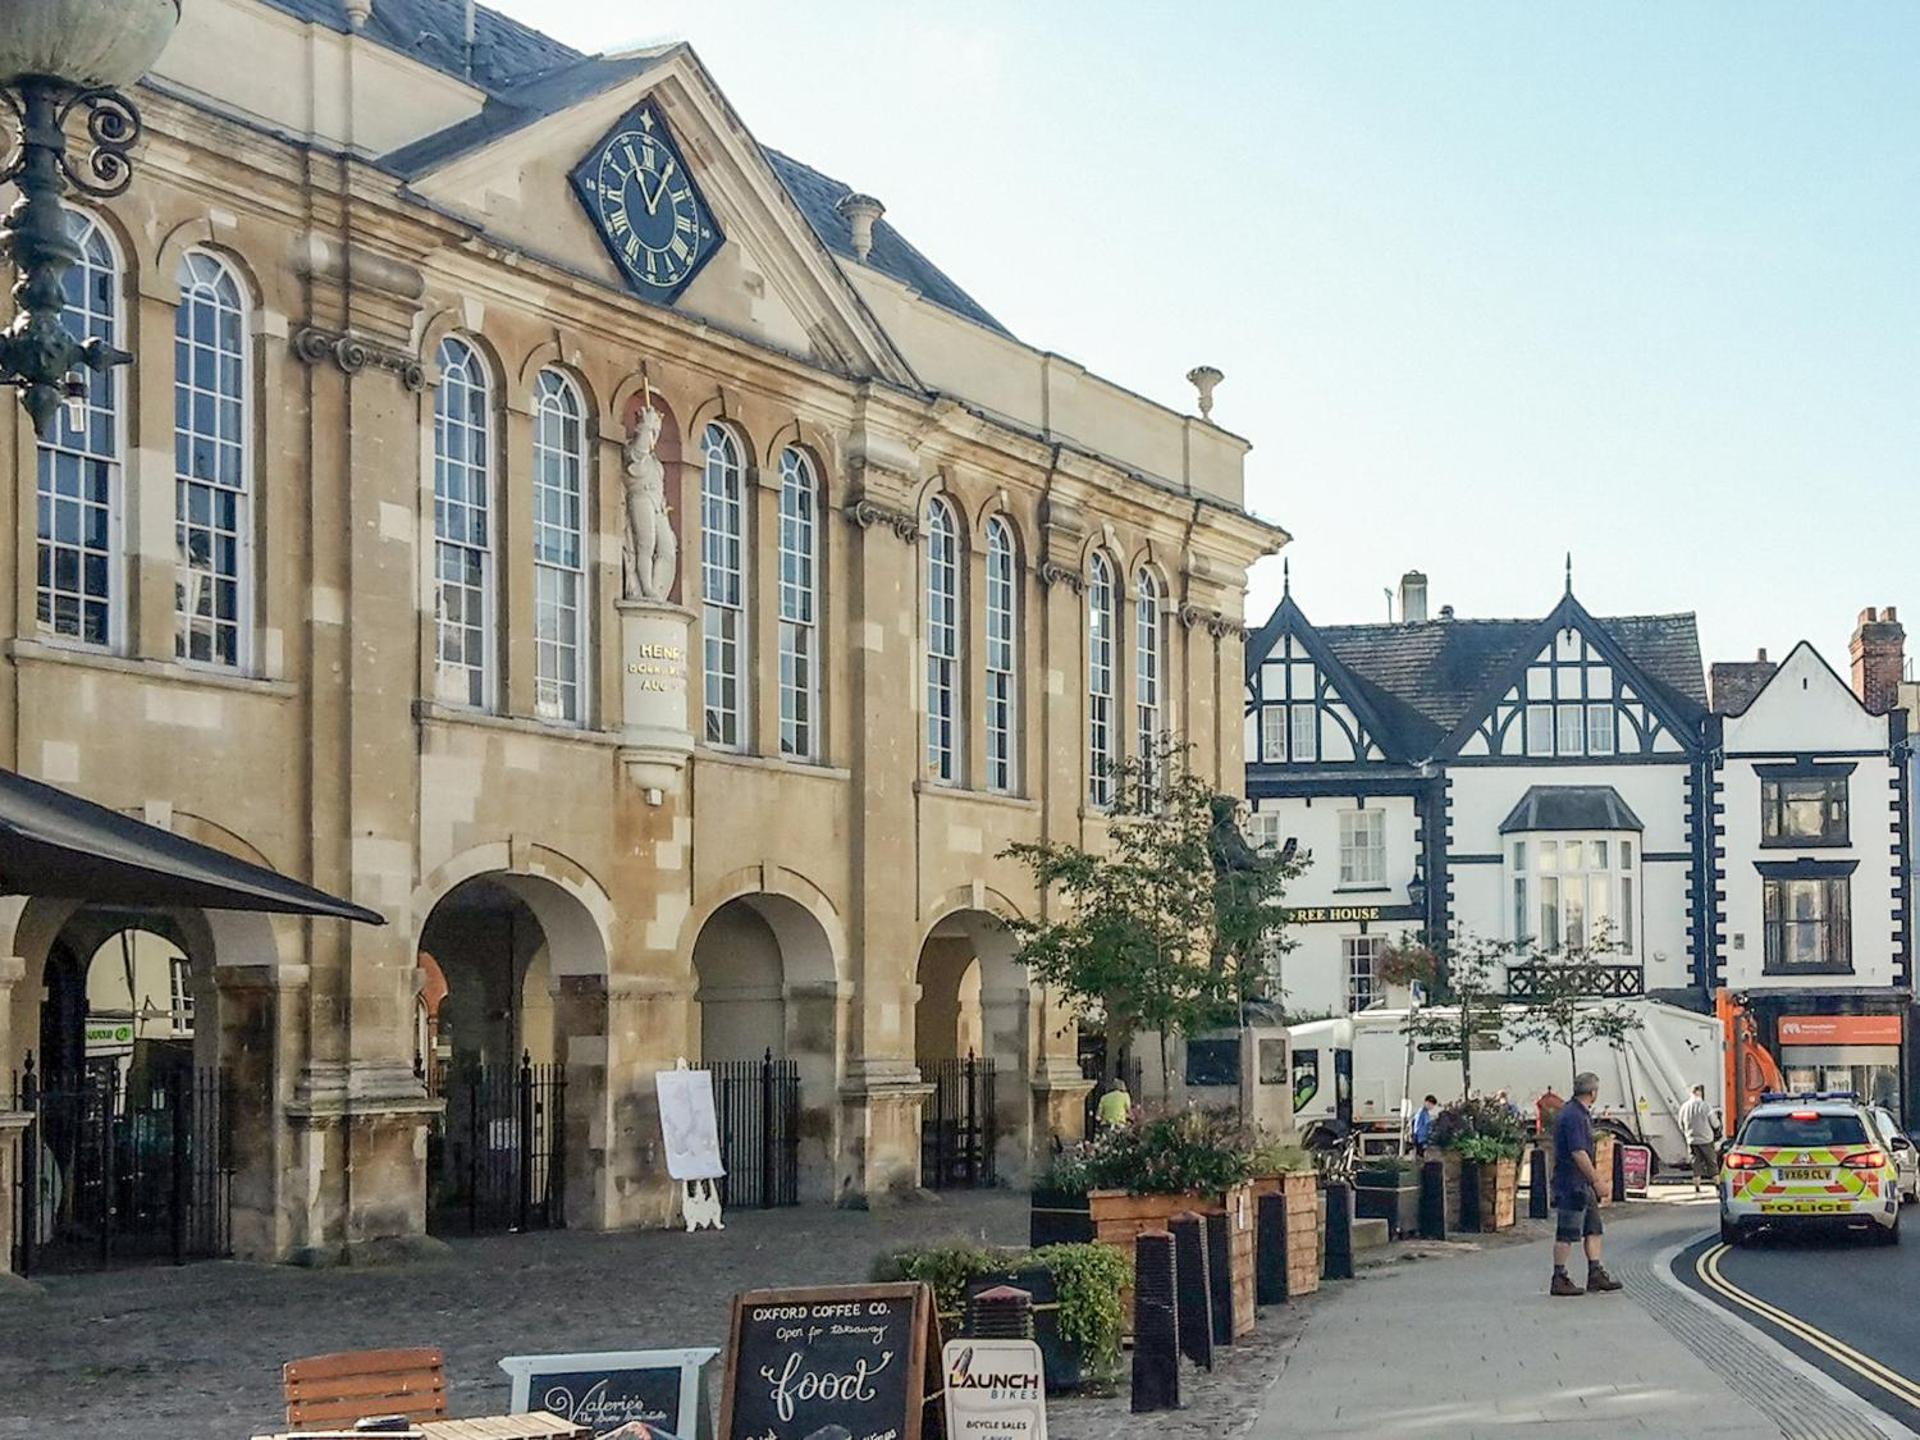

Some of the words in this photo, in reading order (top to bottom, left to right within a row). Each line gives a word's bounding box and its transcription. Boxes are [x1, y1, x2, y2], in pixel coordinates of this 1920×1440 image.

[1329, 907, 1379, 920] HOUSE
[1761, 1203, 1850, 1213] POLICE
[753, 1306, 807, 1321] OXFORD
[812, 1303, 861, 1318] COFFEE
[868, 1302, 891, 1315] CO.
[776, 1327, 803, 1342] Open
[808, 1325, 823, 1344] for
[830, 1324, 888, 1345] takeaway
[760, 1351, 894, 1422] food
[949, 1373, 1039, 1389] LAUNCH
[544, 1378, 644, 1422] Valerie's
[990, 1389, 1038, 1400] BIKES
[966, 1420, 999, 1430] BICYCLE
[1001, 1420, 1027, 1430] SALES
